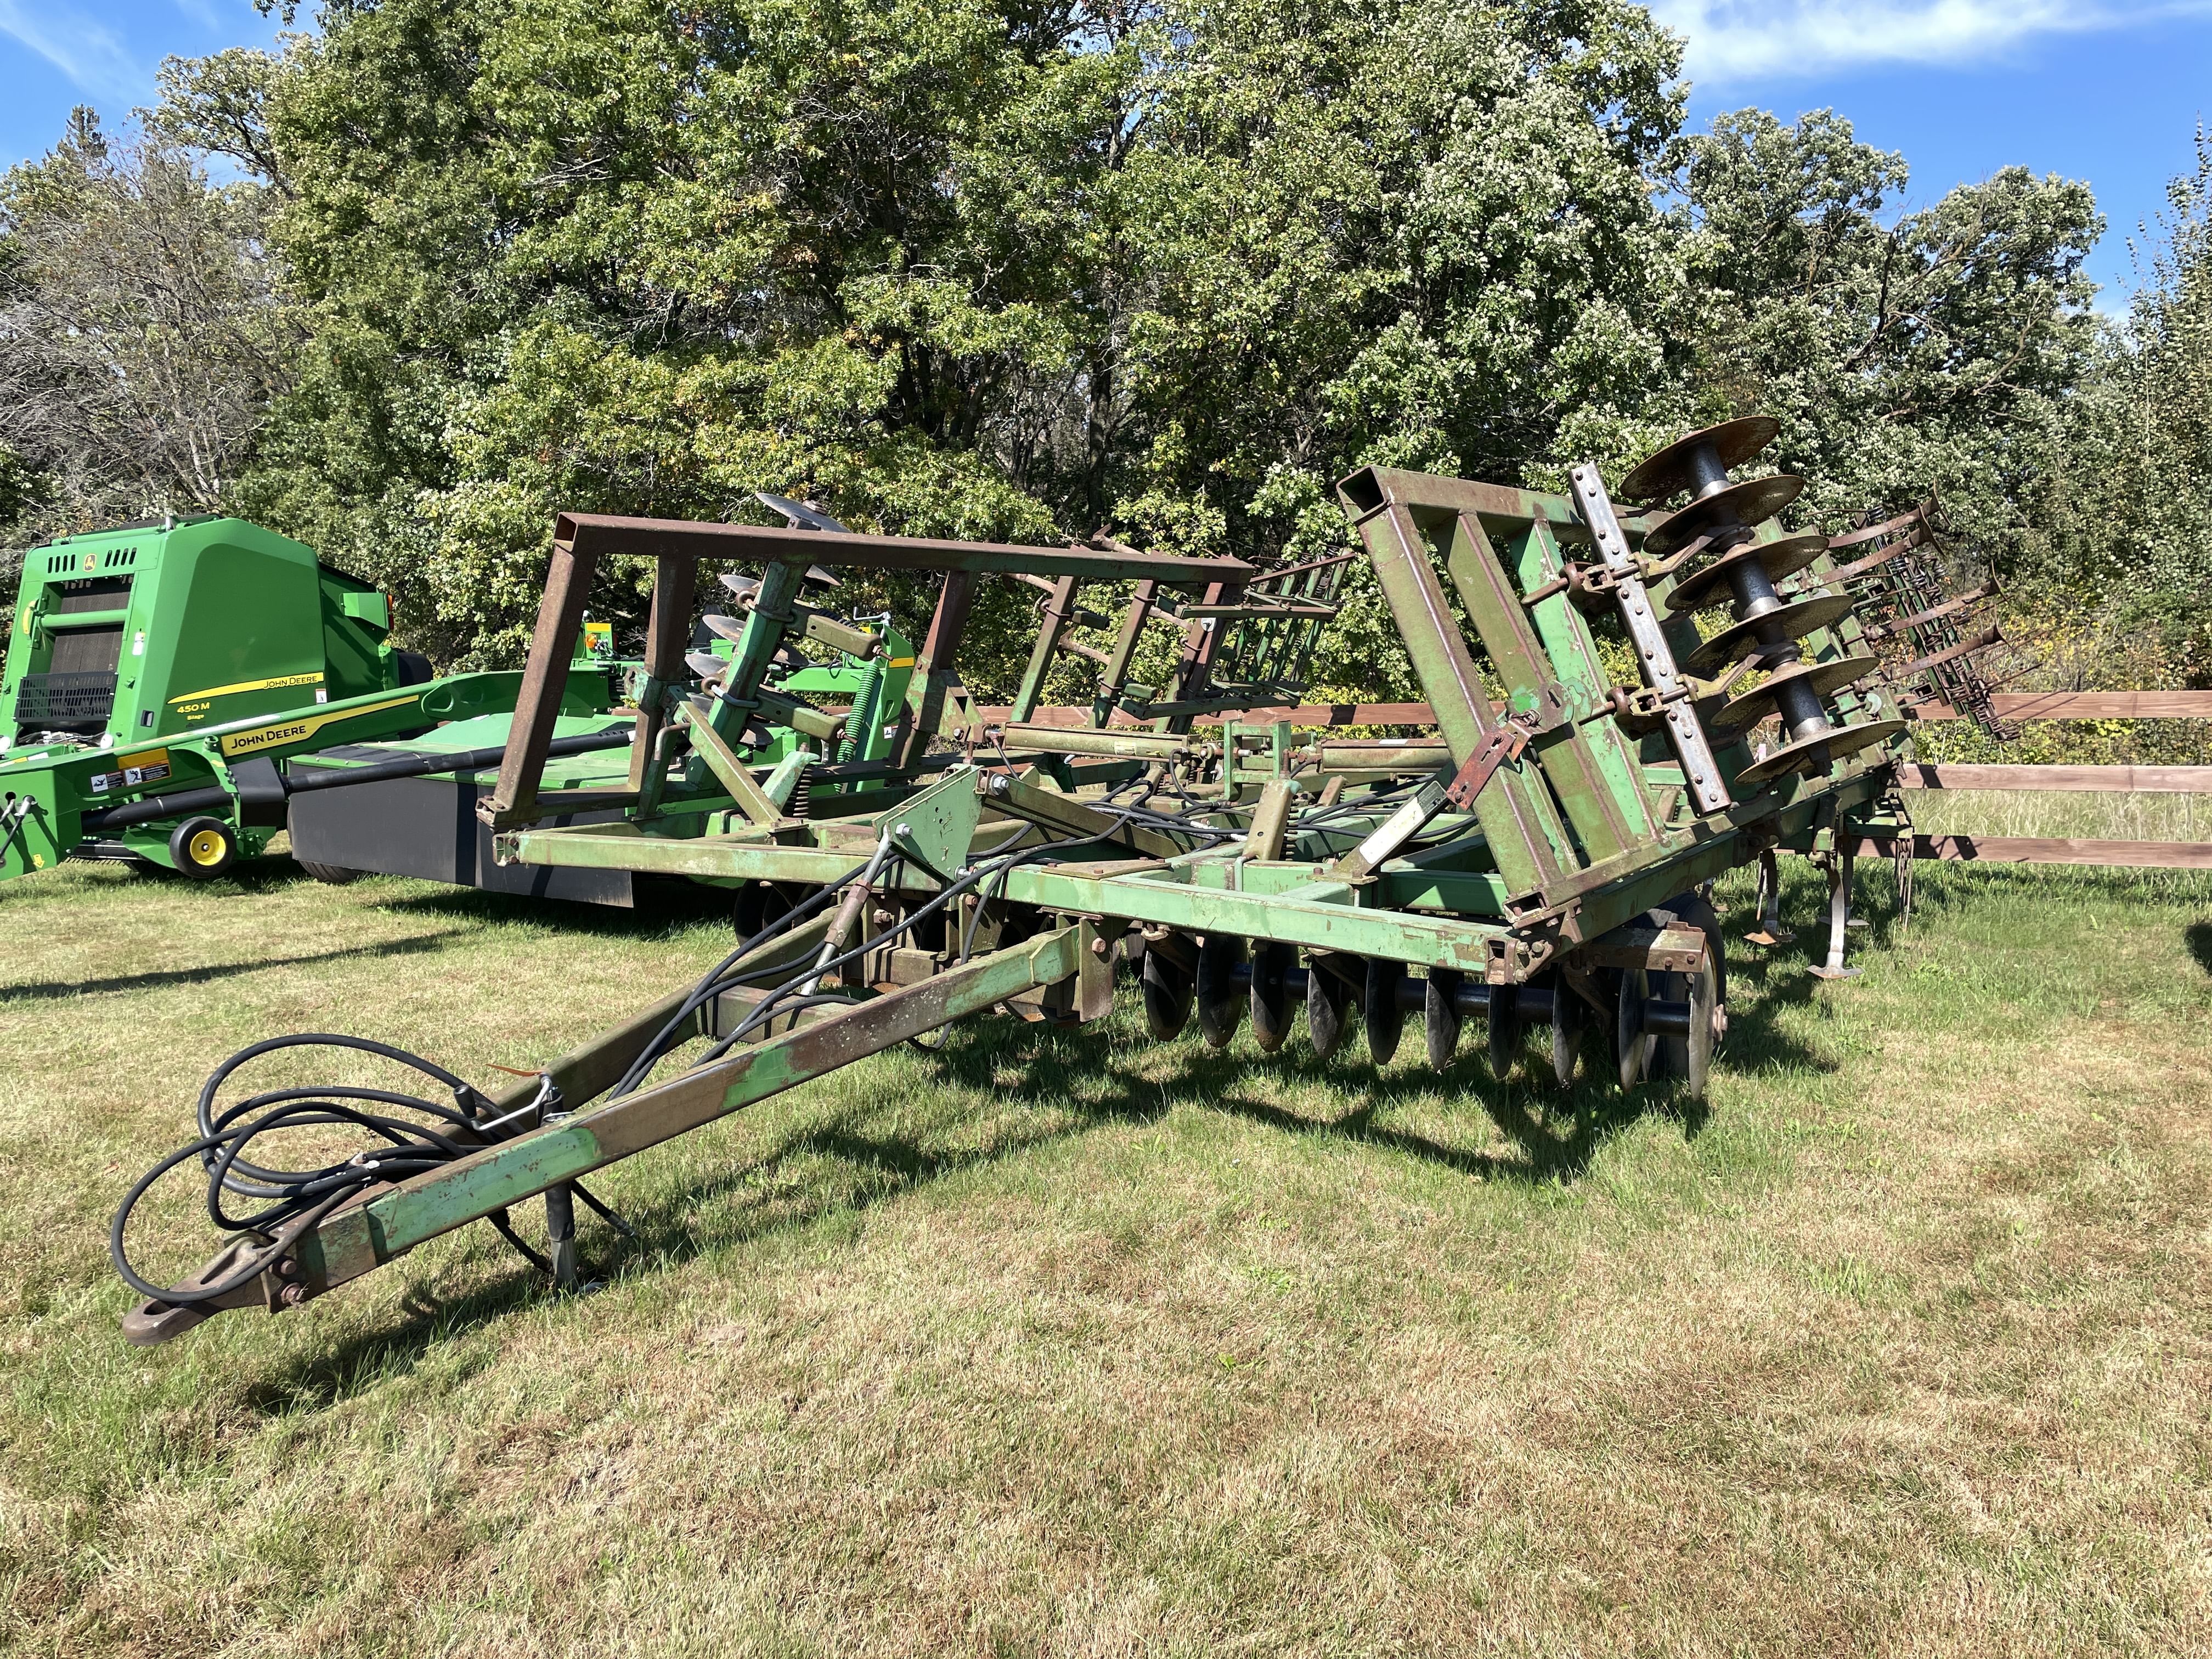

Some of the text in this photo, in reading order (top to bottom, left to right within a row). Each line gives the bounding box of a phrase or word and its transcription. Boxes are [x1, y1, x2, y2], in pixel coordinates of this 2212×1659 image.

[263, 676, 317, 689] JOHN DEERE
[177, 702, 210, 713] 450 M
[231, 725, 306, 749] JOHN DEERE
